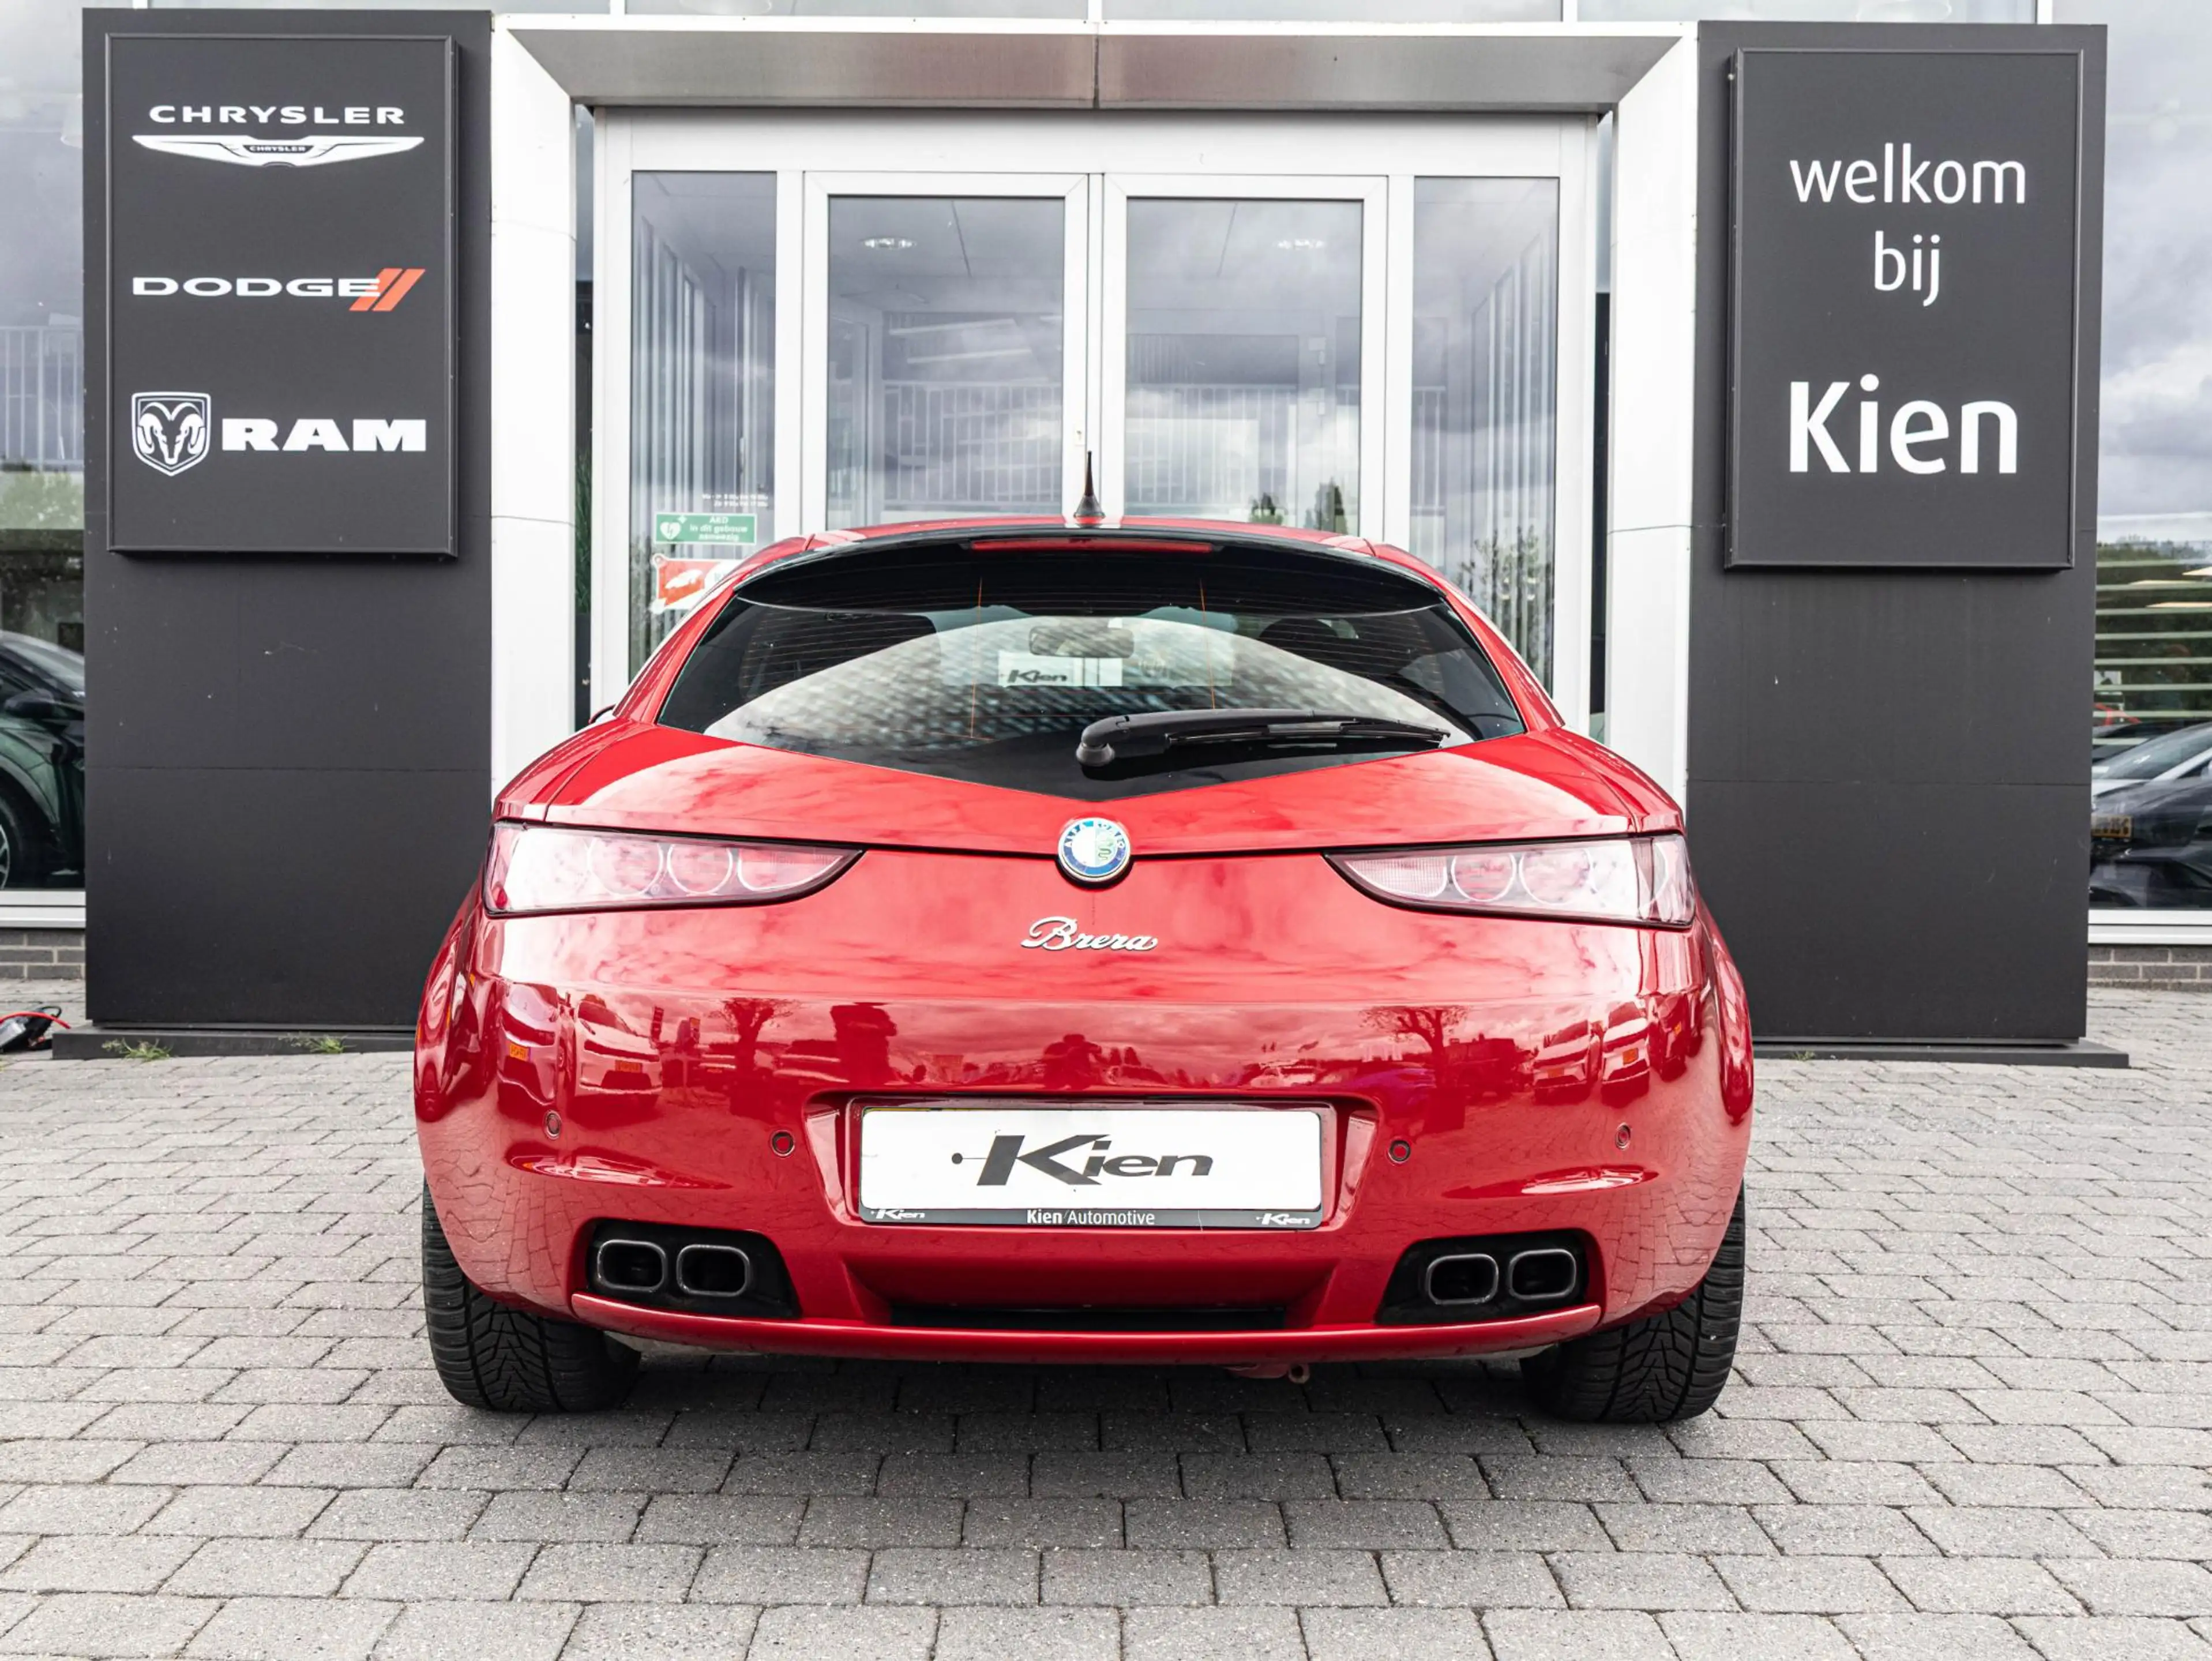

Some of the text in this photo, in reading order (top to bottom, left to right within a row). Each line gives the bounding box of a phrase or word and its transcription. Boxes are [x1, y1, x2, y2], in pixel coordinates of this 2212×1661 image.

[149, 105, 404, 125] CHRYSLER
[1789, 142, 2026, 204] welkom
[1874, 230, 1940, 307] bij
[132, 277, 381, 297] DODGE
[221, 418, 427, 452] RAM
[1789, 373, 2018, 475] Kien
[1020, 916, 1159, 951] Brera
[977, 1134, 1214, 1186] Kien
[876, 1209, 1311, 1226] Kien Kien Automotive Kien
